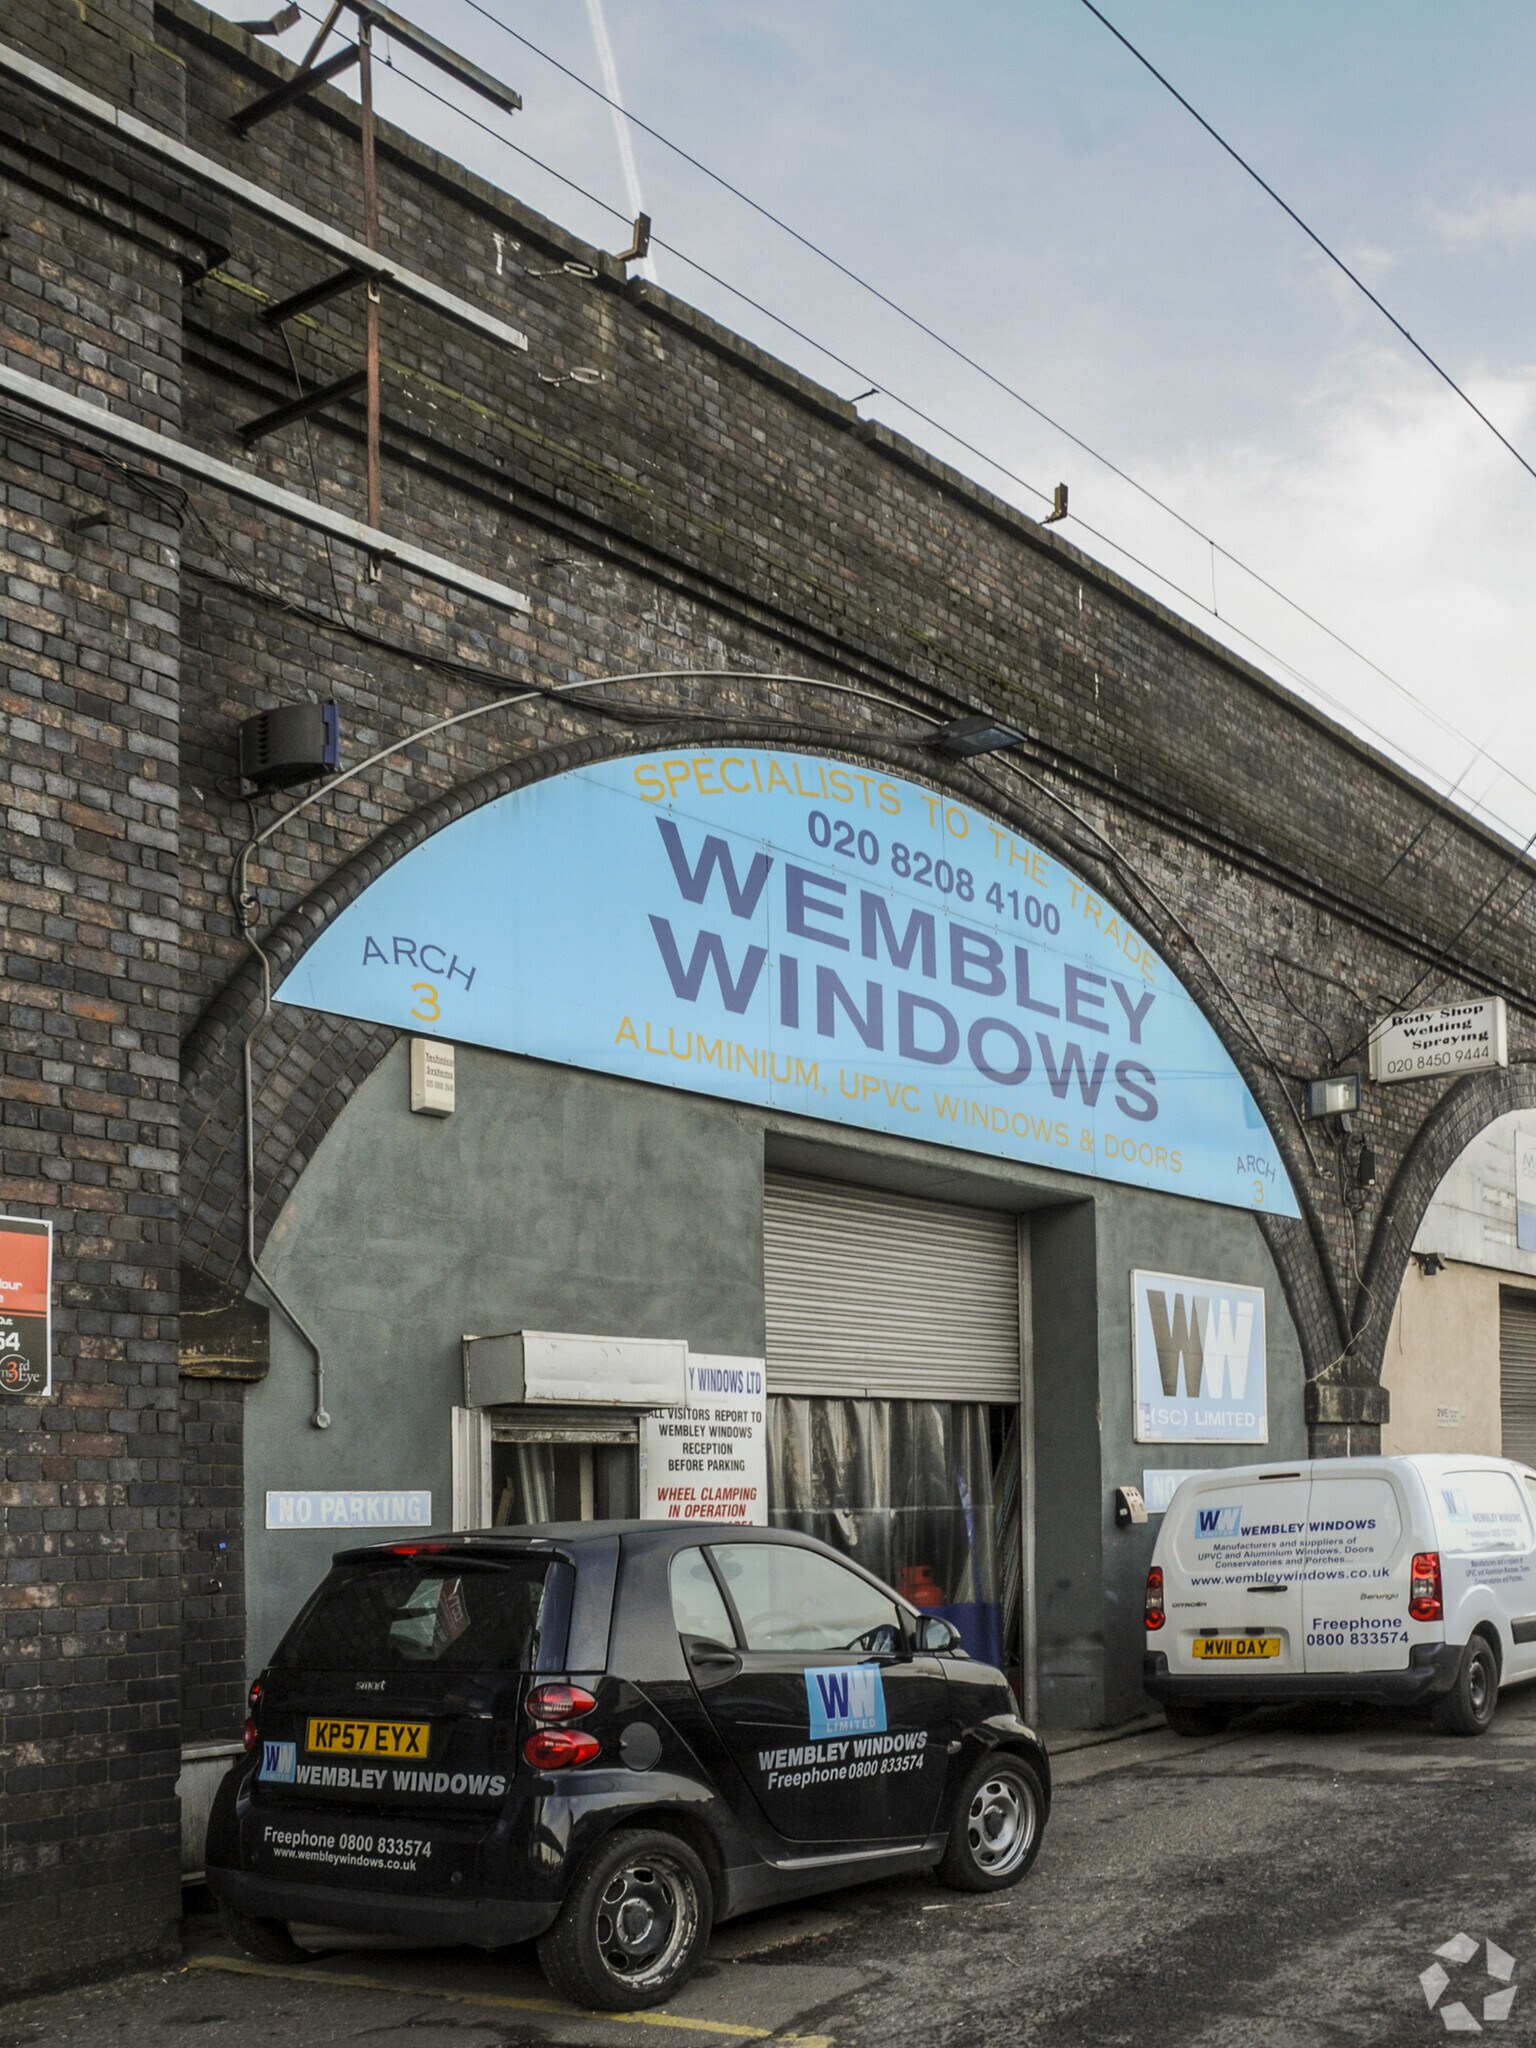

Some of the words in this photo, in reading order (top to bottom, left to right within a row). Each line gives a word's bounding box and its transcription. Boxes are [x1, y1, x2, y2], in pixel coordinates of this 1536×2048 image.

[634, 757, 901, 815] SPECIALISTS
[920, 796, 969, 839] TO
[988, 824, 1050, 889] THE
[1067, 878, 1158, 983] TRADE
[807, 810, 880, 866] 020
[891, 841, 975, 903] 8208
[985, 881, 1060, 936] 4100
[655, 816, 1156, 1045] WEMBLEY
[362, 935, 476, 992] ARCH
[410, 982, 441, 1022] 3
[647, 913, 1159, 1122] WINDOWS
[1392, 1013, 1434, 1027] Body
[1440, 1004, 1484, 1019] Shop
[1403, 1018, 1473, 1038] Welding
[1412, 1030, 1489, 1050] Spraying
[1387, 1058, 1413, 1074] 020
[1417, 1052, 1451, 1069] 8450
[1455, 1046, 1490, 1062] 9444
[614, 1016, 828, 1096] ALUMINIUM,
[839, 1069, 921, 1113] UPVC
[933, 1091, 1070, 1148] WINDOWS
[1078, 1127, 1094, 1153] &
[1104, 1134, 1183, 1174] DOORS
[1237, 1154, 1276, 1183] ARCH
[1252, 1179, 1265, 1205] 3
[698, 1367, 744, 1393] WINDOWS
[746, 1371, 761, 1395] LTD
[668, 1408, 710, 1421] VISITORS
[714, 1410, 748, 1423] REPORT
[751, 1411, 762, 1423] TO
[1150, 1408, 1188, 1427] (SC)
[1195, 1410, 1256, 1427] LIMITED
[658, 1424, 706, 1437] WEMBLEY
[708, 1426, 752, 1438] WINDOWS
[682, 1443, 733, 1455] RECEPTION
[668, 1459, 704, 1471] BEFORE
[707, 1459, 745, 1471] PARKING
[657, 1487, 697, 1501] WHEEL
[701, 1487, 757, 1500] CLAMPING
[279, 1497, 312, 1523] NO
[320, 1496, 421, 1522] PARKING
[668, 1505, 681, 1518] IN
[684, 1504, 746, 1518] OPERATION
[1240, 1522, 1305, 1537] WEMBLEY
[1309, 1519, 1376, 1532] WINDOWS
[1198, 1552, 1222, 1561] UPVC
[1225, 1551, 1241, 1560] and
[1243, 1548, 1293, 1559] Aluminium
[1344, 1545, 1374, 1554] Doors
[1213, 1542, 1276, 1551] Manufacturers
[1279, 1540, 1297, 1548] and
[1299, 1538, 1343, 1549] suppliers
[1346, 1537, 1357, 1546] of
[1215, 1558, 1283, 1569] Conservatories
[1285, 1556, 1302, 1565] and
[1191, 1567, 1390, 1586] www.wembleywindows.co.uk
[1312, 1618, 1402, 1636] Freephone
[1204, 1640, 1232, 1655] MV11
[1307, 1632, 1344, 1646] 0800
[1350, 1631, 1409, 1645] 833574
[355, 1680, 386, 1690] smart
[826, 1718, 877, 1733] LIMITED
[315, 1722, 369, 1750] KP57
[375, 1725, 421, 1752] EYX
[758, 1741, 850, 1771] WEMBLEY
[853, 1730, 928, 1758] WINDOWS
[296, 1764, 387, 1790] WEMBLEY
[393, 1771, 506, 1797] WINDOWS
[767, 1766, 847, 1790] Freephone
[849, 1759, 878, 1779] 0800
[880, 1753, 924, 1775] 833574
[264, 1826, 335, 1850] Freephone
[339, 1833, 373, 1851] 0800
[377, 1838, 432, 1858] 833574
[273, 1847, 416, 1871] www.wembleywindows.co.uk
